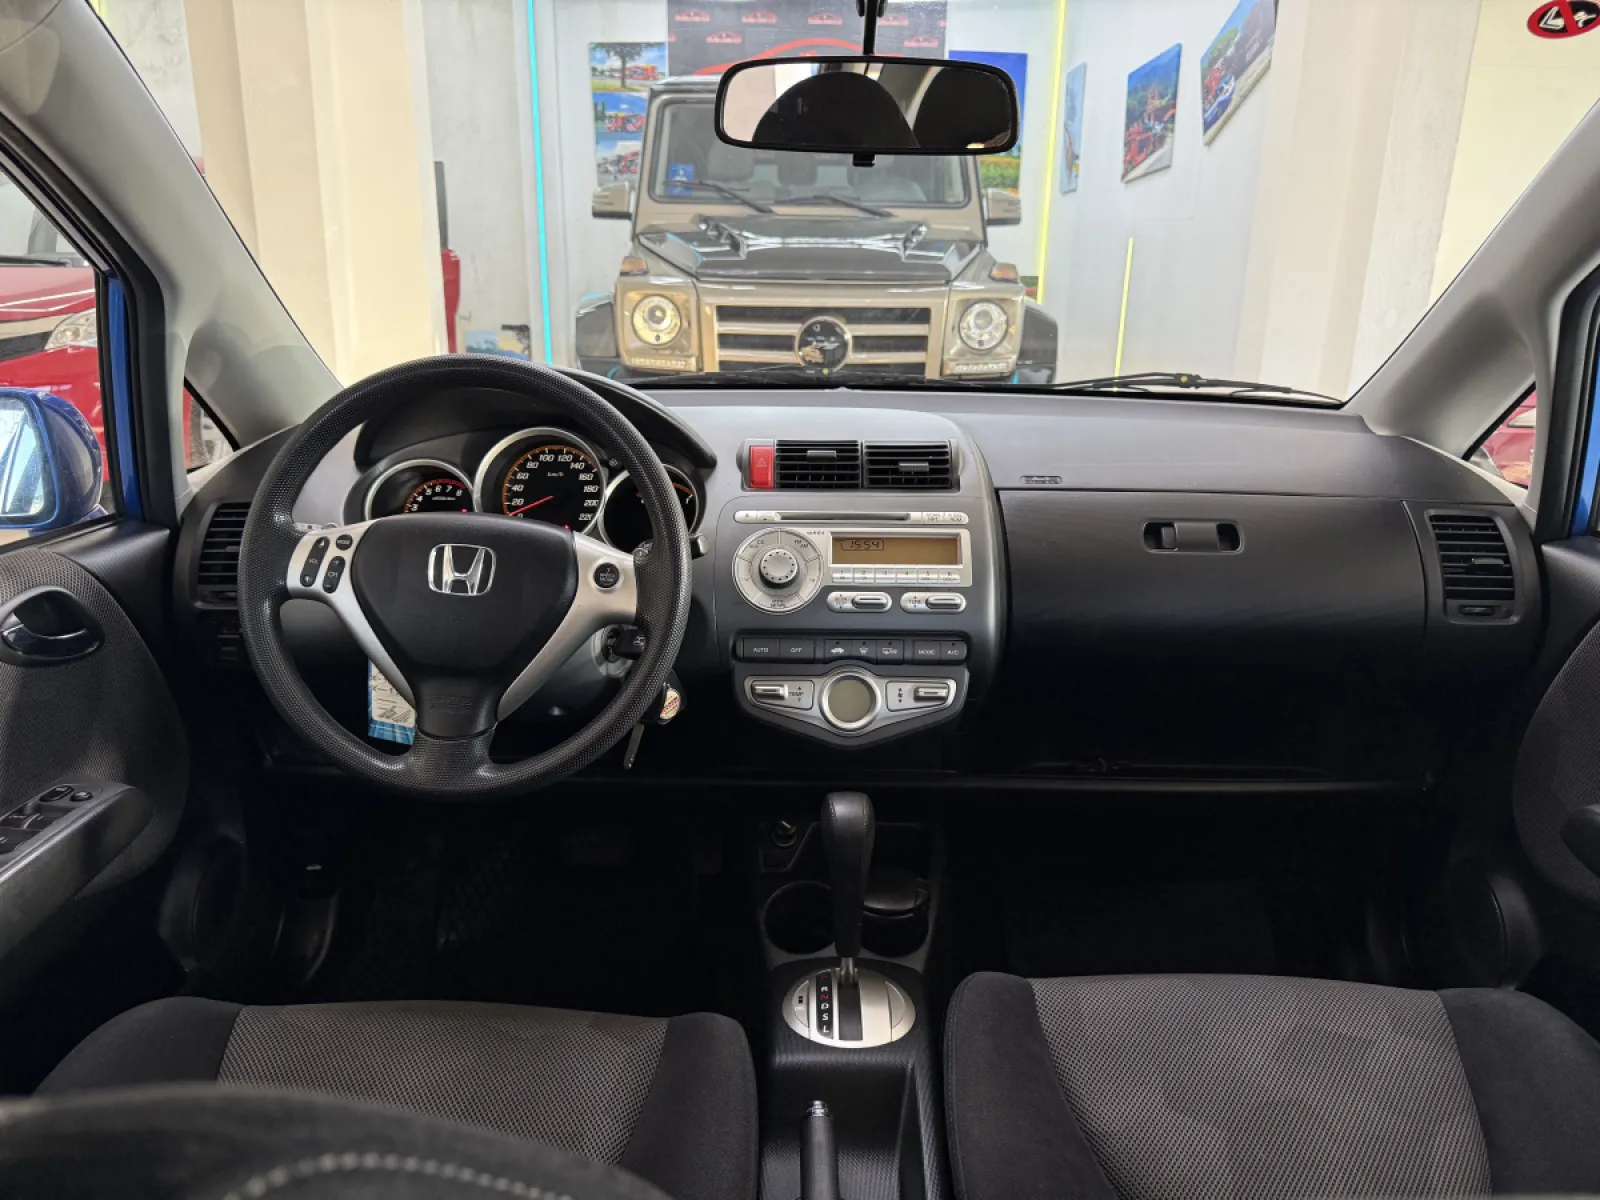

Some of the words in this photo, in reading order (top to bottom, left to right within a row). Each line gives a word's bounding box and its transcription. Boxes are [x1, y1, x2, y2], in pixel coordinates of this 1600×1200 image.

[539, 454, 555, 462] 100
[557, 454, 573, 462] 120
[526, 461, 539, 469] 80
[570, 462, 585, 470] 140
[516, 472, 530, 480] 60
[578, 473, 594, 481] 160
[425, 487, 433, 496] 5
[435, 484, 442, 493] 6
[445, 484, 453, 493] 7
[511, 484, 524, 492] 40
[583, 485, 599, 493] 180
[511, 498, 524, 506] 20
[583, 499, 600, 507] 200
[411, 503, 419, 512] 3
[822, 1012, 829, 1021] S
[823, 1025, 830, 1033] L
